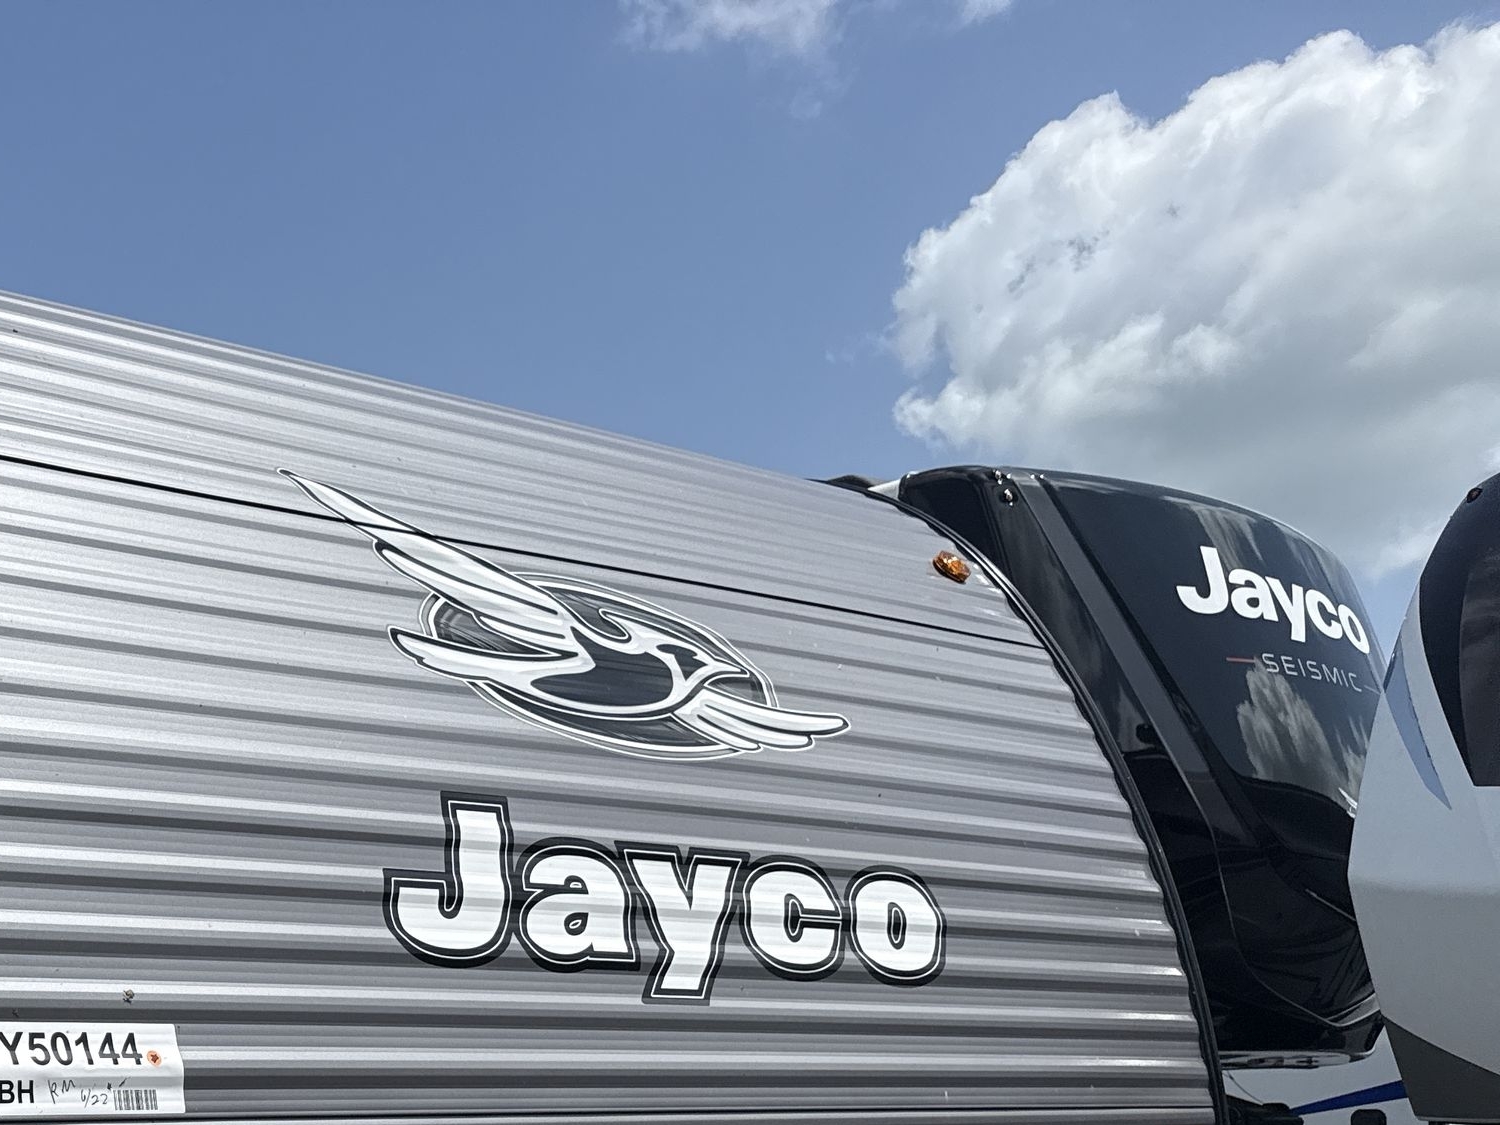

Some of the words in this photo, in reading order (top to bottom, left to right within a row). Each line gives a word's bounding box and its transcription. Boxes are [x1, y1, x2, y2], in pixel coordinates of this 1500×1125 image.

[1175, 545, 1370, 654] Jayco
[1260, 652, 1362, 693] SEISMIC
[383, 790, 947, 1005] Jayco
